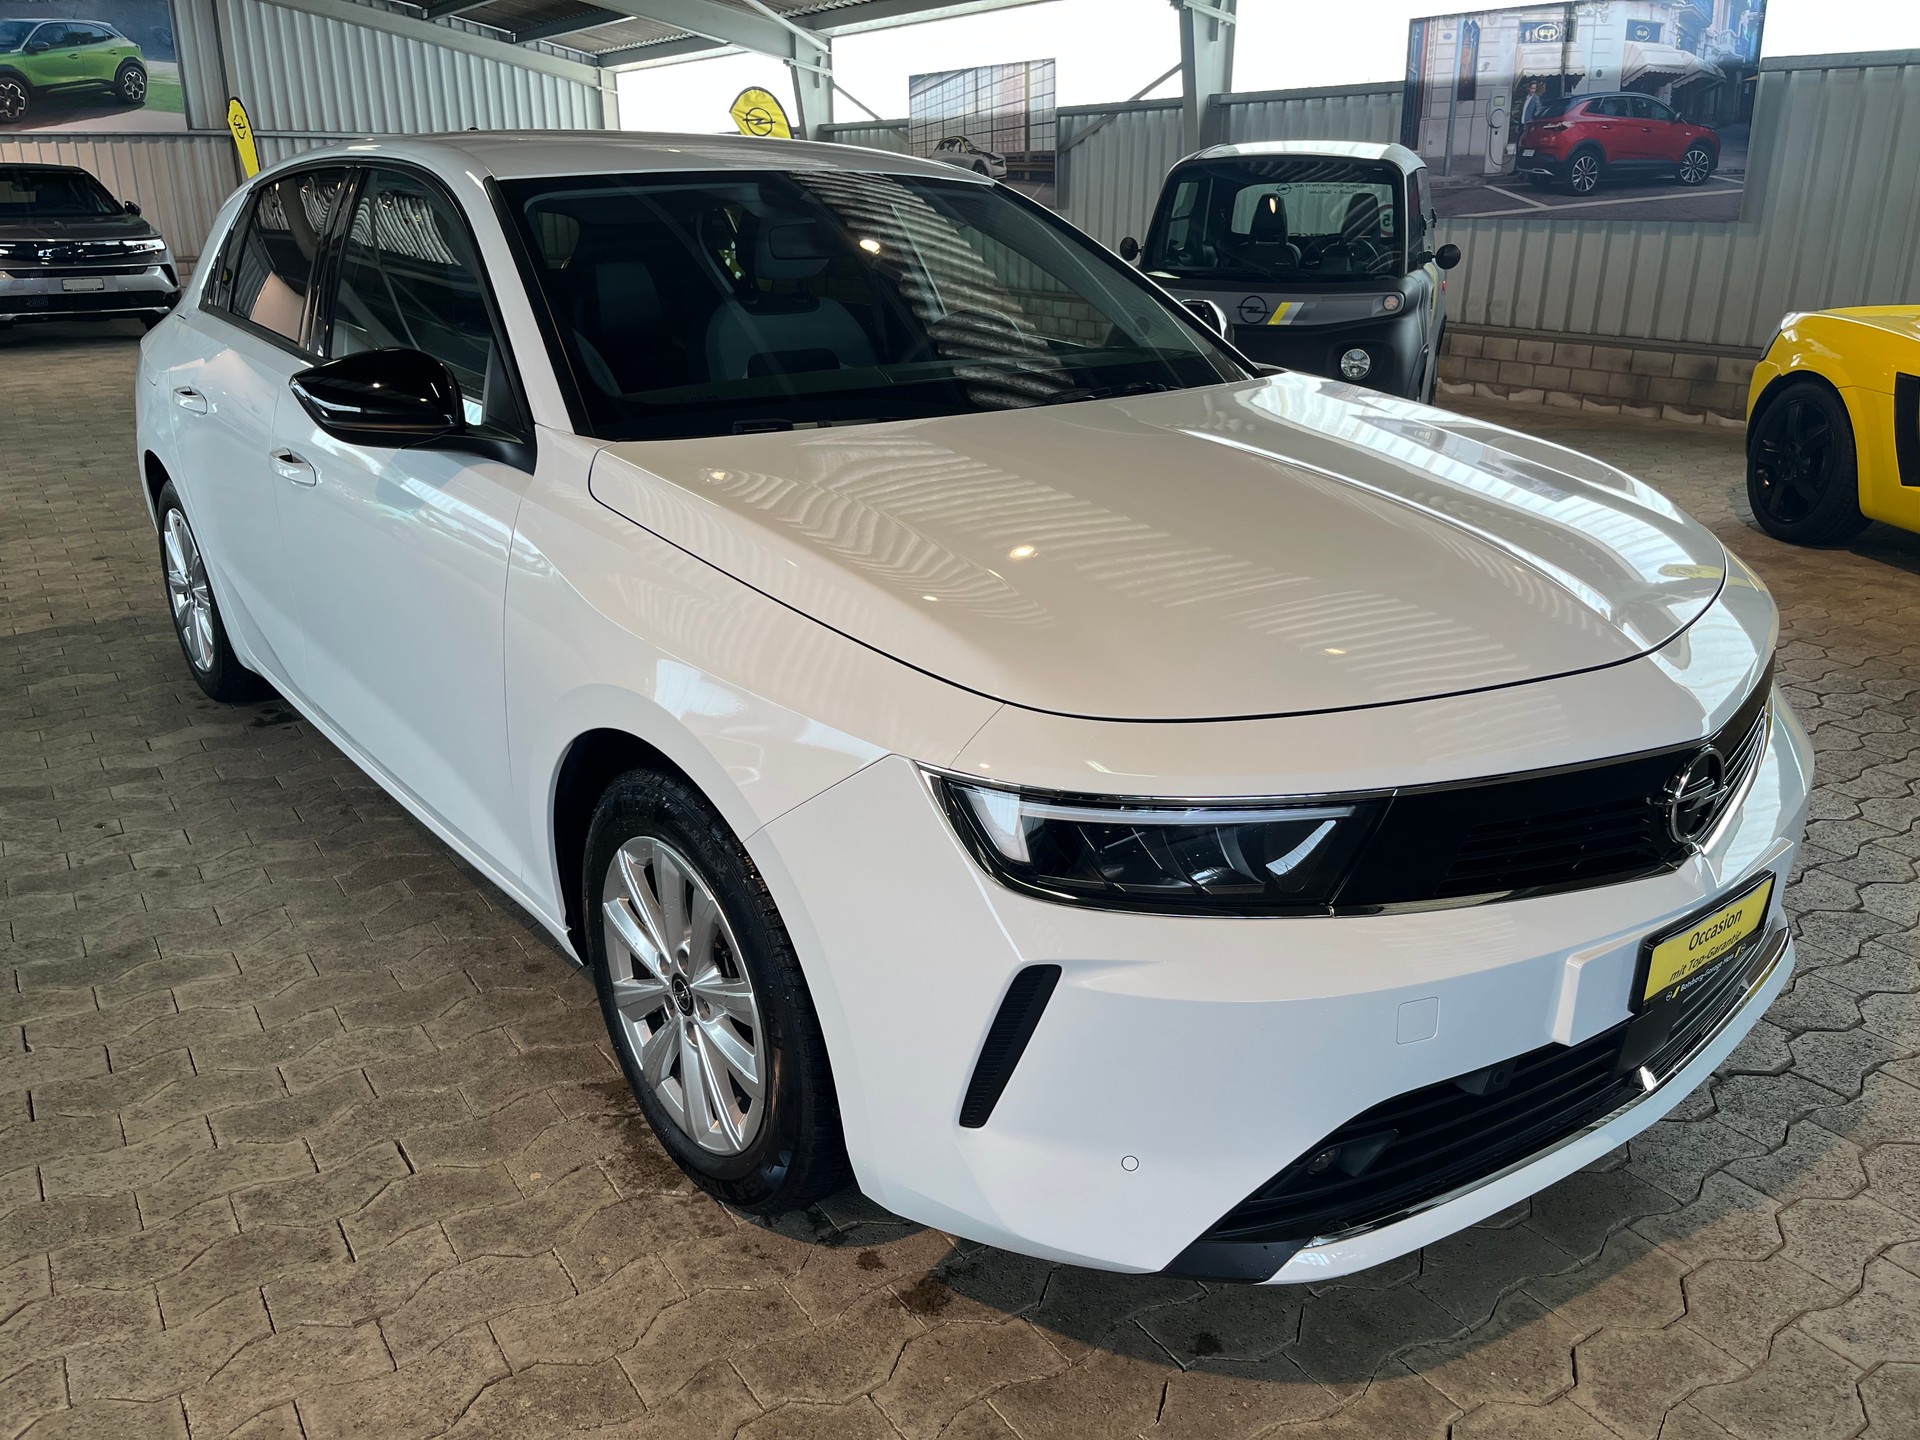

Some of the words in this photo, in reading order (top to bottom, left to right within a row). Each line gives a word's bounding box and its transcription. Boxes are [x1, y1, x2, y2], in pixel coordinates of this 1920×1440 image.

[1688, 909, 1743, 951] Occasion
[1669, 964, 1687, 982] mit
[1687, 930, 1742, 972] Top-Garantie
